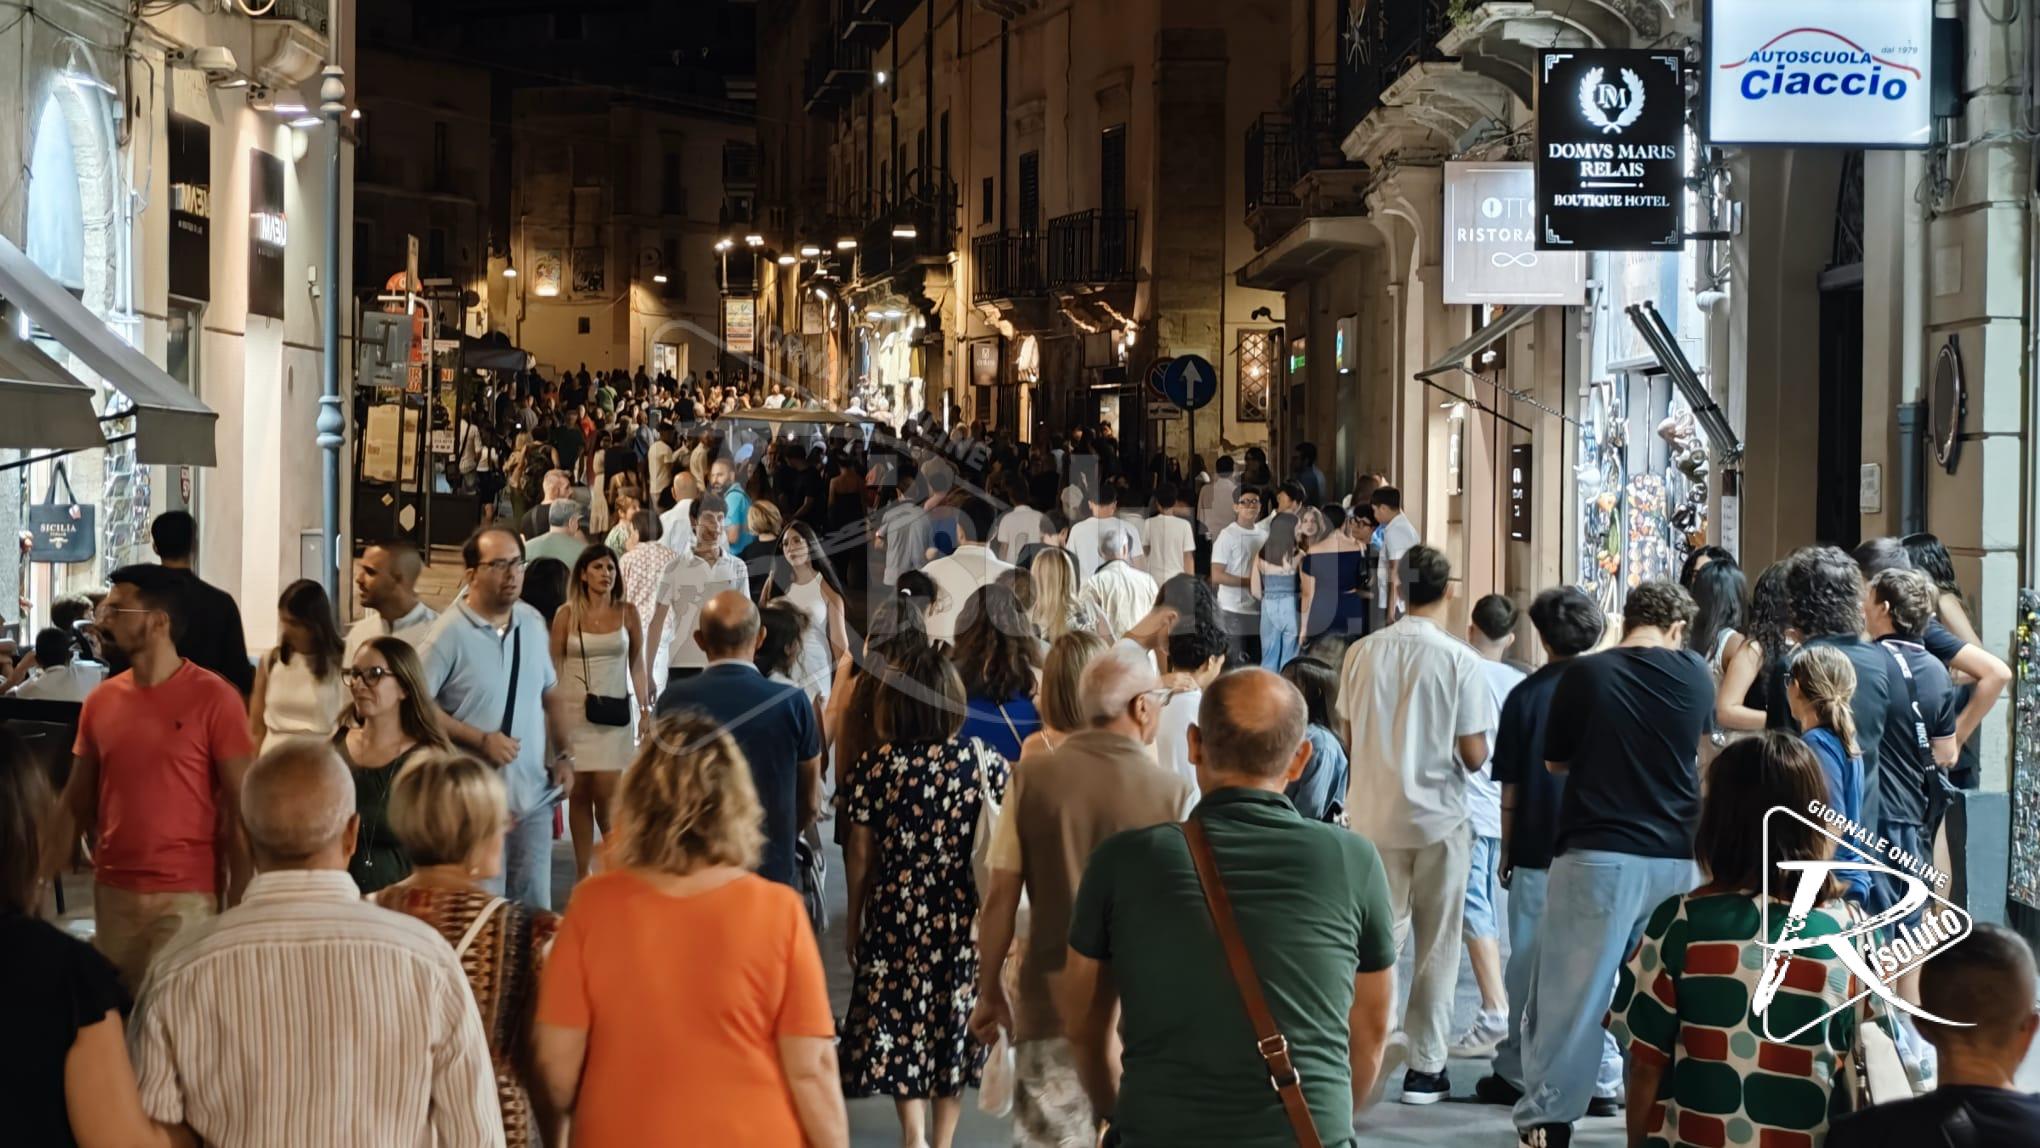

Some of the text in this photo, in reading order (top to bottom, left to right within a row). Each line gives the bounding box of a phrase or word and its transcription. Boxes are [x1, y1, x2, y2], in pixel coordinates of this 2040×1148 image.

[1749, 51, 1872, 64] AUTOSCUOLA
[1740, 65, 1907, 100] Ciaccio
[1549, 143, 1676, 160] DOMVS MARIS
[1580, 162, 1645, 178] RELAIS
[1554, 194, 1670, 207] BOUTIQUE HOTEL
[40, 523, 77, 533] SICILIA
